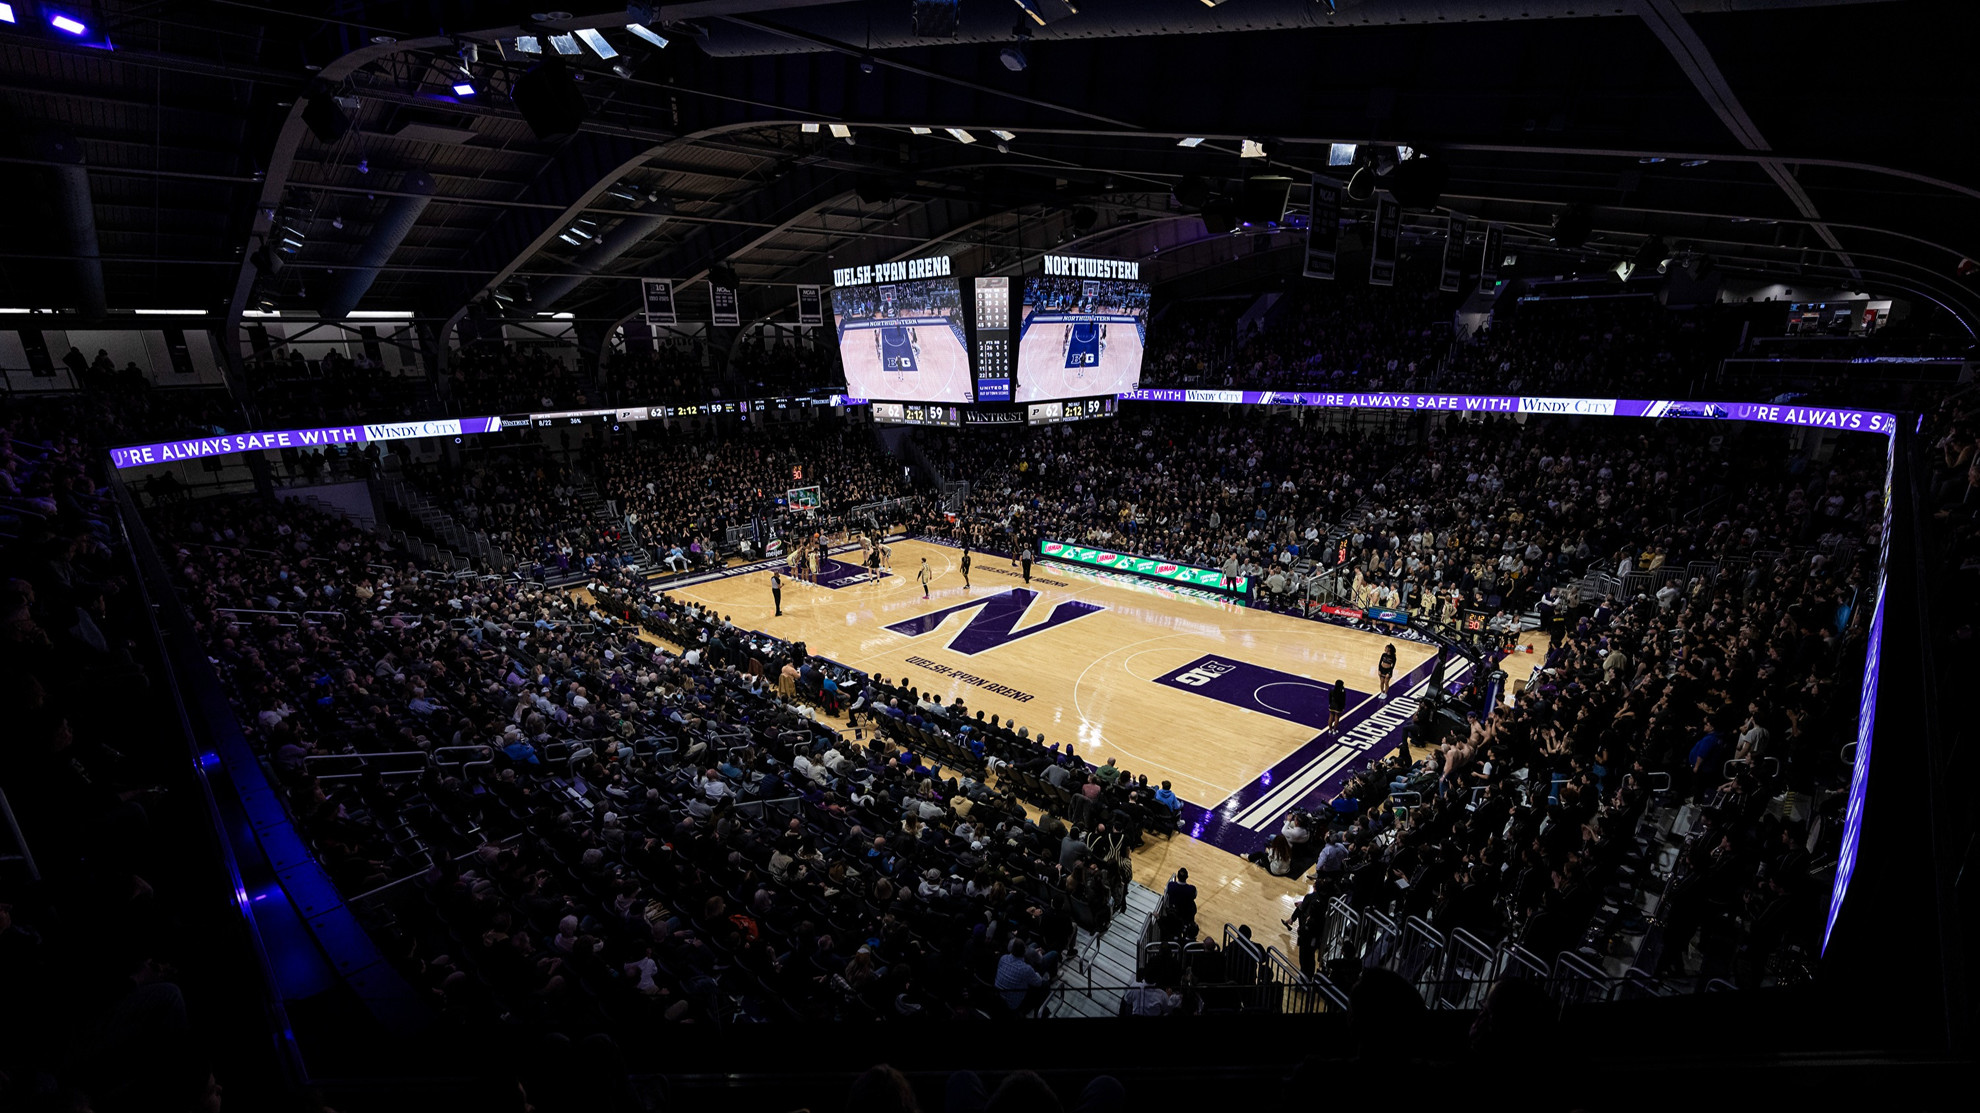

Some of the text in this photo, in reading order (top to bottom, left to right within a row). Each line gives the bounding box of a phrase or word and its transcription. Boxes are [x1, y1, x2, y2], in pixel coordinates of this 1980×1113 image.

[834, 256, 950, 286] WELSH-RYAN ARENA
[1044, 255, 1138, 280] NORTHWESTERN
[1124, 391, 1181, 400] SAFE WITH
[1188, 390, 1216, 400] WINDY
[711, 404, 722, 412] 59
[740, 402, 747, 412] N
[1088, 400, 1100, 412] 59
[1106, 399, 1111, 412] N
[1350, 395, 1410, 407] ALWAYS
[1416, 396, 1458, 409] SAFE
[1465, 397, 1511, 411] WITH
[1522, 399, 1614, 414] WINDY CITY
[651, 408, 662, 417] 62
[678, 406, 697, 415] 2:12
[888, 405, 899, 417] 62
[906, 410, 924, 420] 2:12
[930, 407, 943, 419] 59
[950, 407, 957, 420] N
[966, 410, 1023, 422] WINTRUST
[1046, 404, 1058, 417] 62
[1065, 406, 1082, 417] 2:12
[1704, 404, 1715, 416] N
[1784, 408, 1862, 428] ALWAYS
[367, 422, 458, 439] WINDY CITY
[162, 438, 232, 461] ALWAYS
[237, 433, 291, 450] SAFE
[298, 428, 357, 445] WITH
[793, 471, 802, 480] 30
[766, 550, 782, 558] meijer
[1045, 544, 1062, 553] LIBMAN
[1097, 554, 1116, 563] LIBMAN
[1155, 565, 1176, 574] LIBMAN
[878, 587, 1112, 658] N
[1469, 614, 1485, 622] 2:12
[1468, 622, 1479, 630] 30
[905, 656, 1035, 703] WELSH-RYAN ARENA
[1338, 696, 1420, 750] WILDCATS
